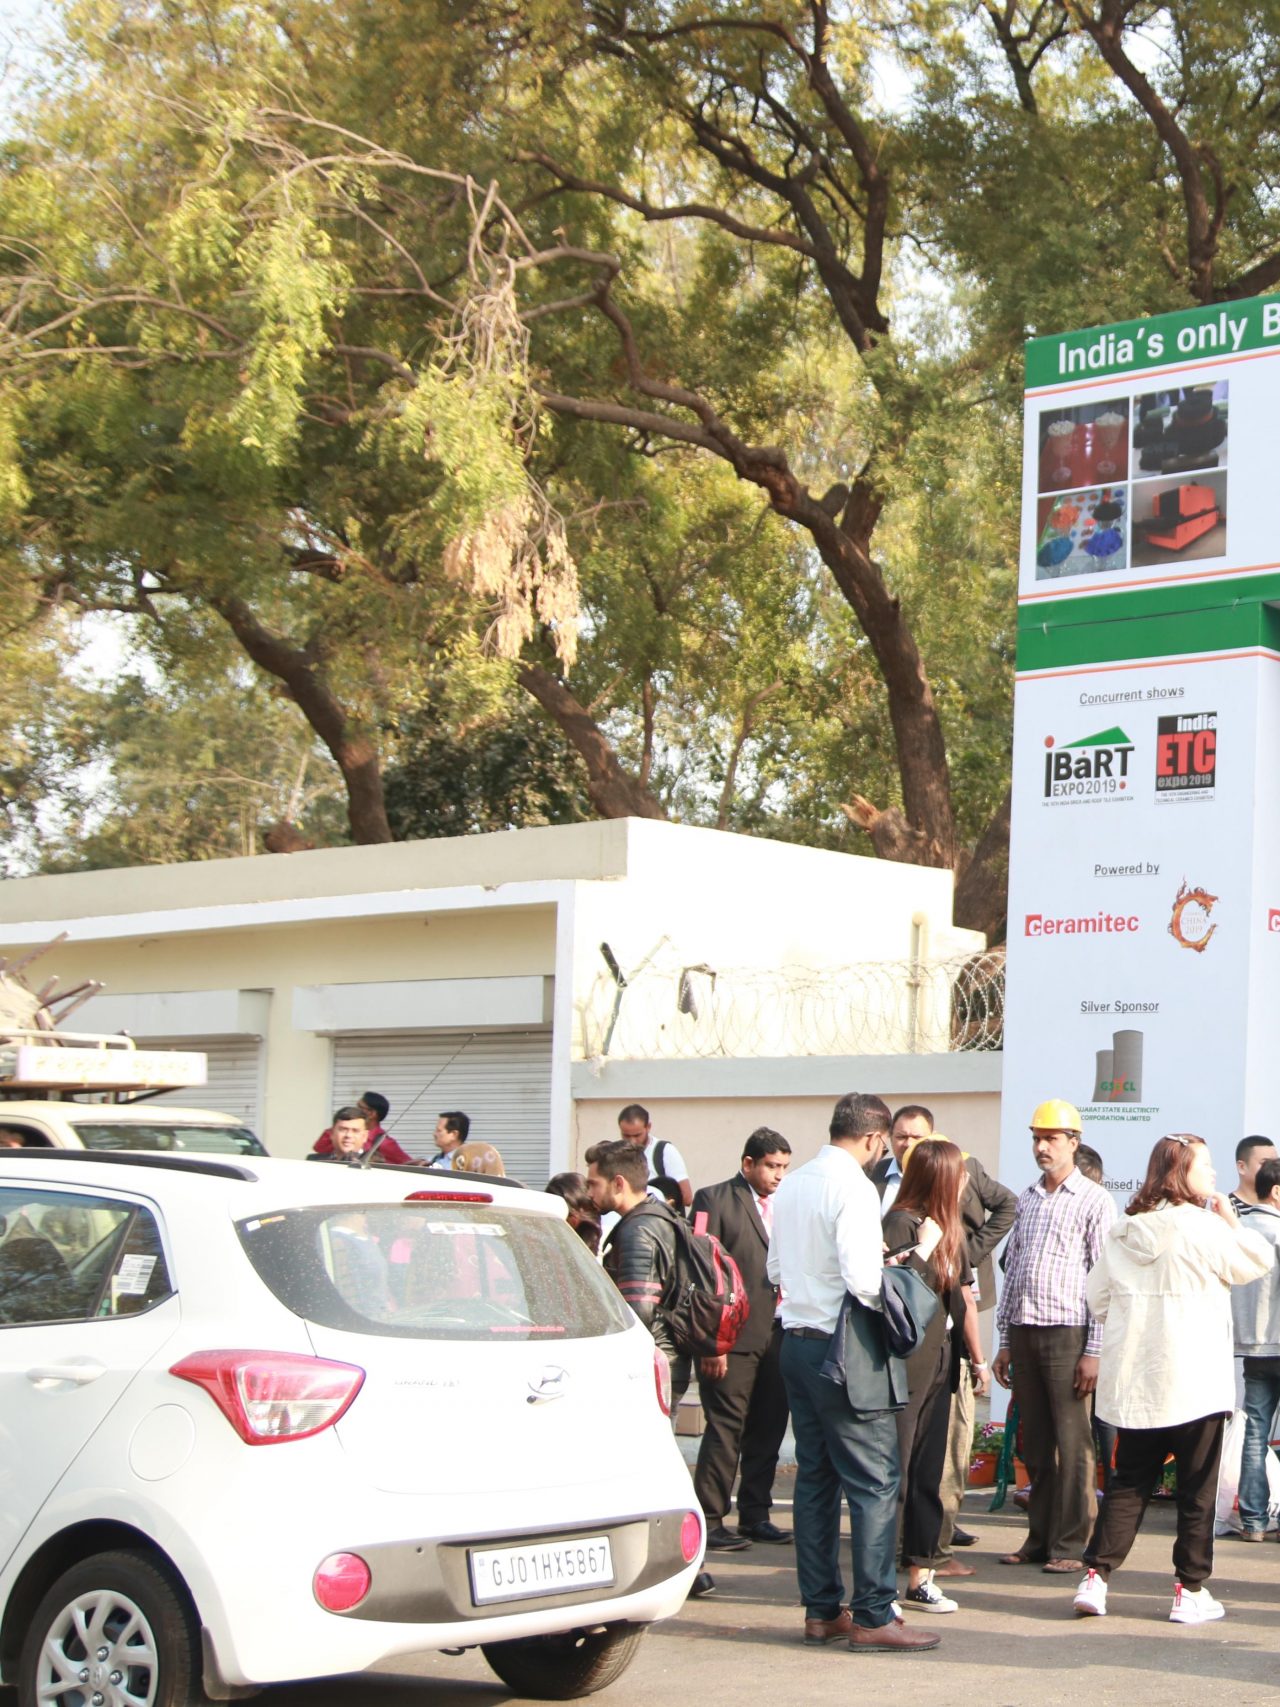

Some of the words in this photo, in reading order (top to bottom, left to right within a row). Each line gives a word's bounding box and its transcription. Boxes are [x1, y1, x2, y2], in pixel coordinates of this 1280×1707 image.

[1058, 327, 1164, 374] India's
[1177, 312, 1248, 352] only
[1079, 690, 1142, 705] Concurrent
[1147, 686, 1185, 699] shows
[1177, 714, 1217, 732] india
[1158, 730, 1217, 776] ETC
[1158, 774, 1188, 789] expo
[1189, 774, 1212, 786] 2019
[1094, 862, 1143, 876] Powered
[1146, 862, 1160, 875] by
[1080, 1000, 1111, 1012] Silver
[1114, 1000, 1160, 1014] Sponsor
[492, 1545, 606, 1586] GJ01HX5867
